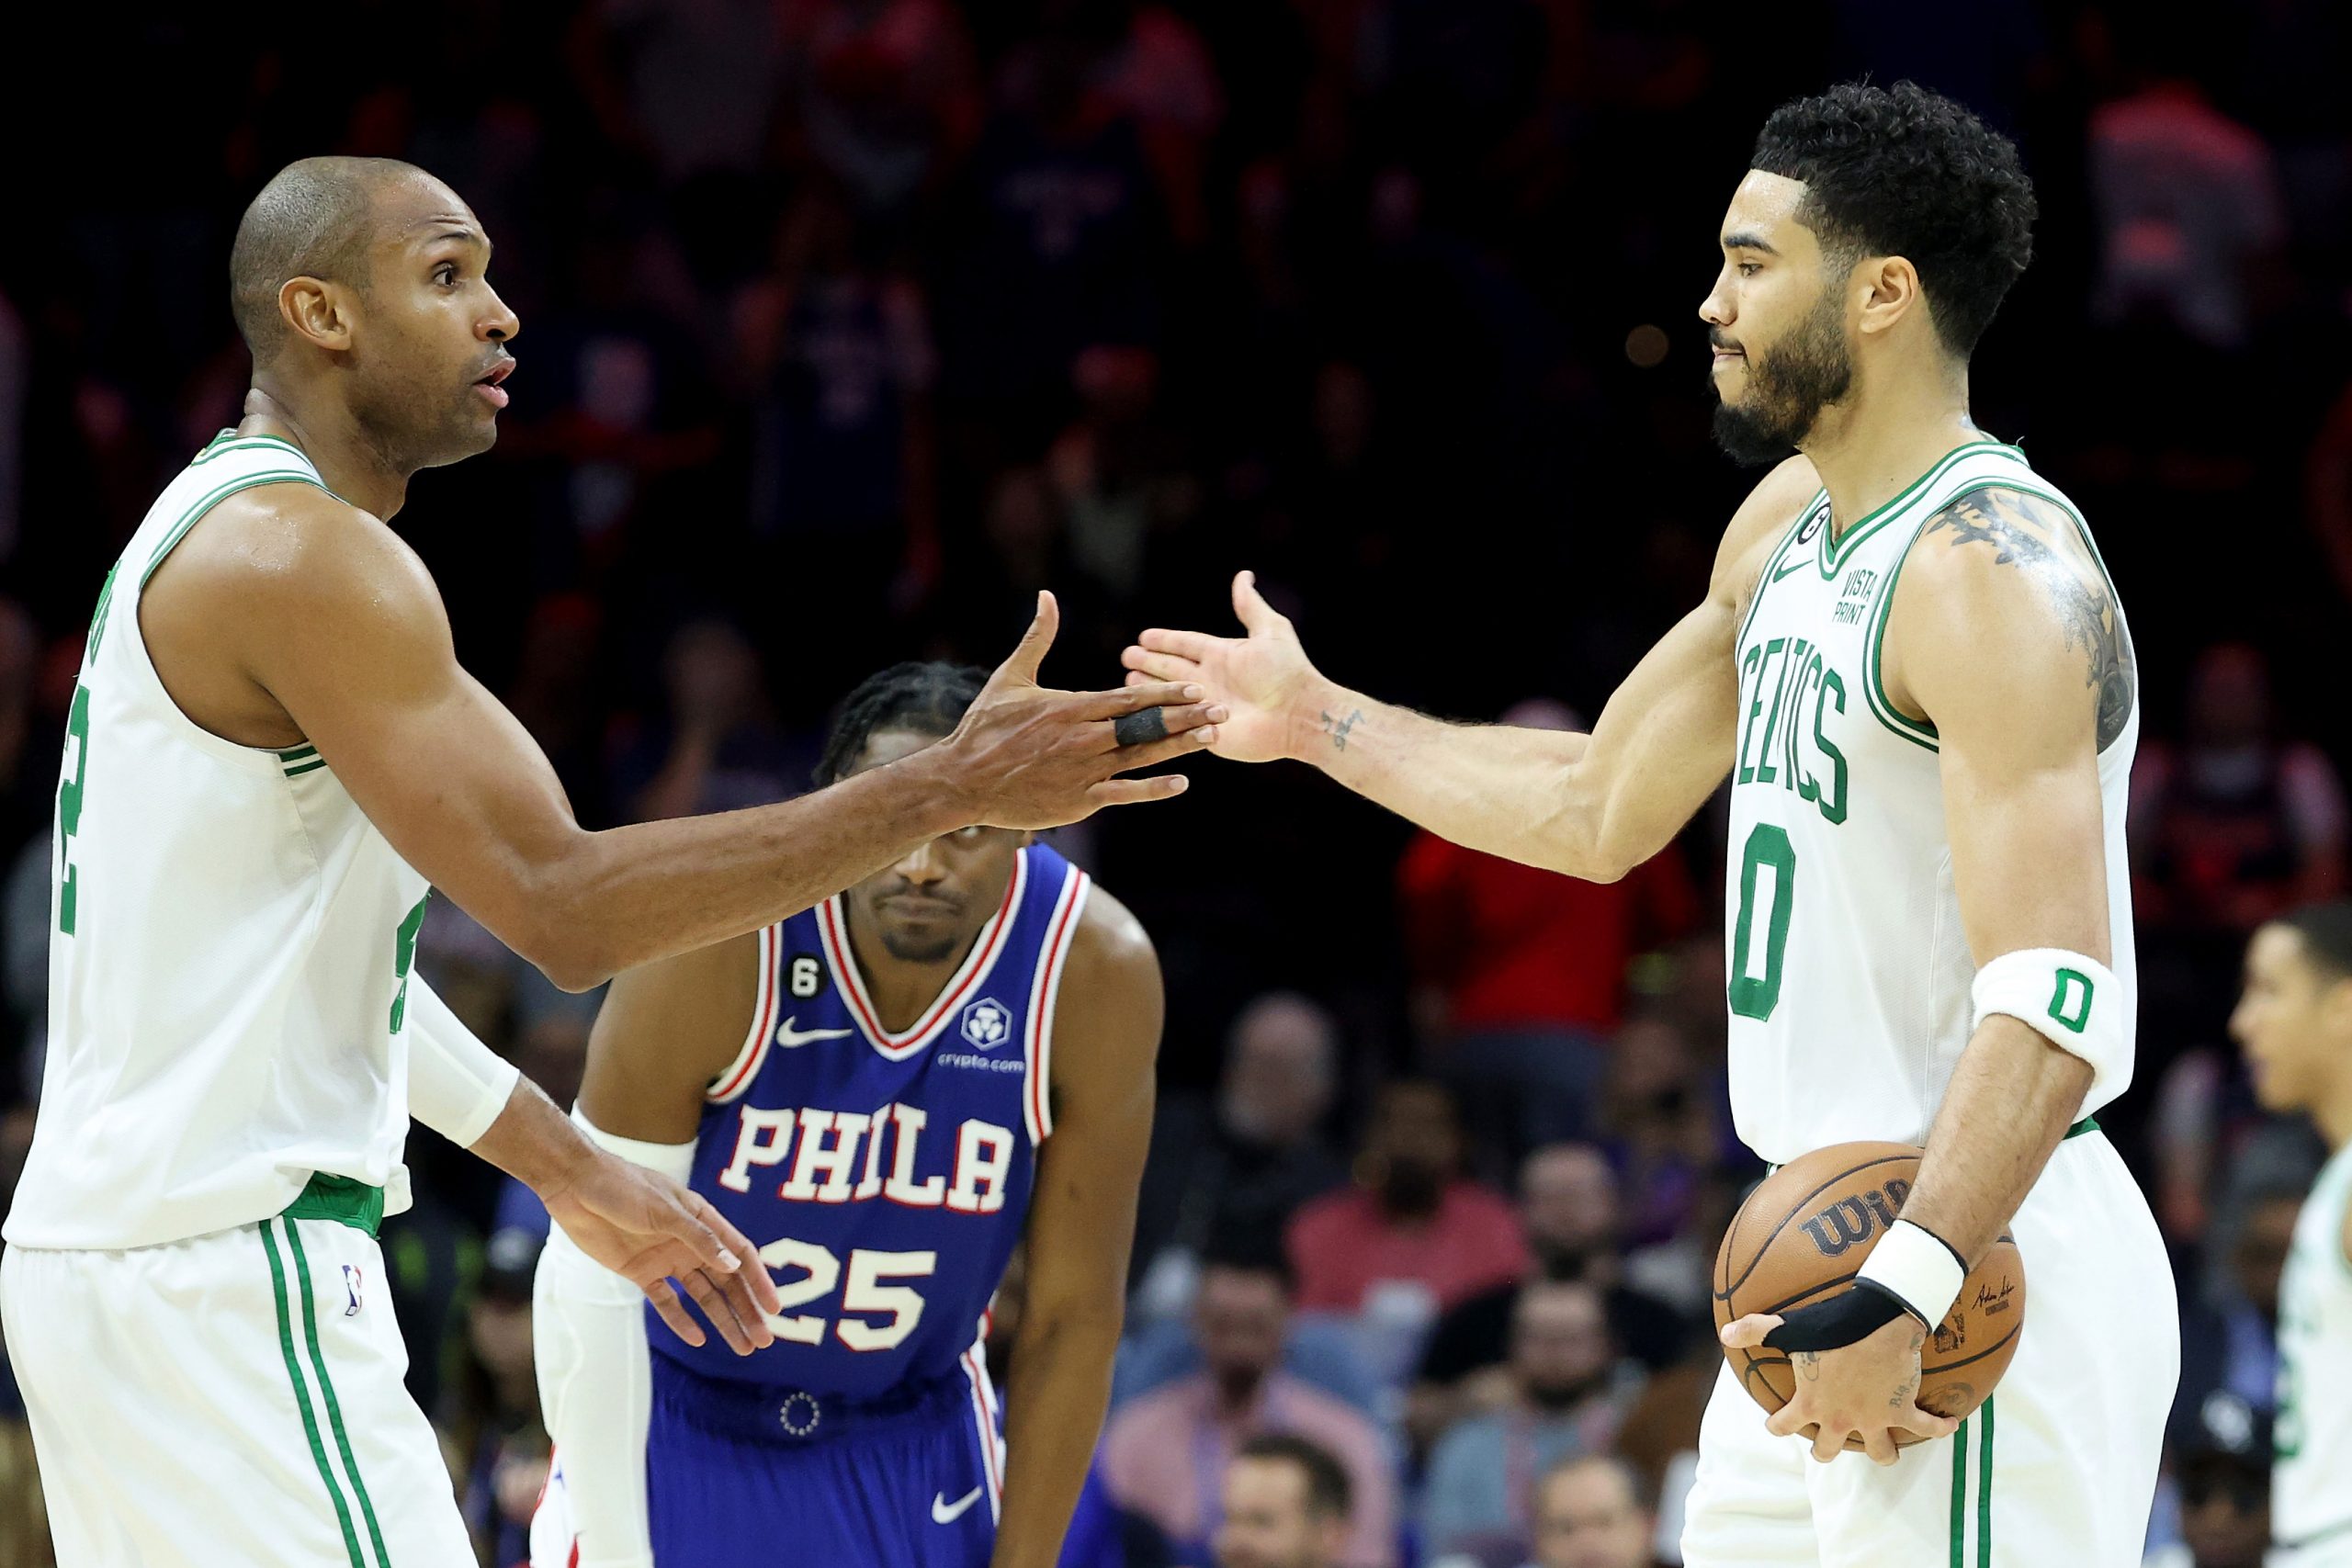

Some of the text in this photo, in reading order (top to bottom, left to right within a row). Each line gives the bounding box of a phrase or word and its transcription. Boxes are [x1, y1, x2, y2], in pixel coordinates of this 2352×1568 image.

[1832, 601, 1866, 626] PRINT
[1842, 569, 1878, 602] VISTA
[1737, 637, 1848, 825] CELTICS
[1728, 822, 1795, 1022] 0
[791, 957, 820, 998] 6
[937, 1053, 1024, 1074] crypto.com
[717, 1101, 1015, 1214] PHILA
[758, 1237, 937, 1352] 25
